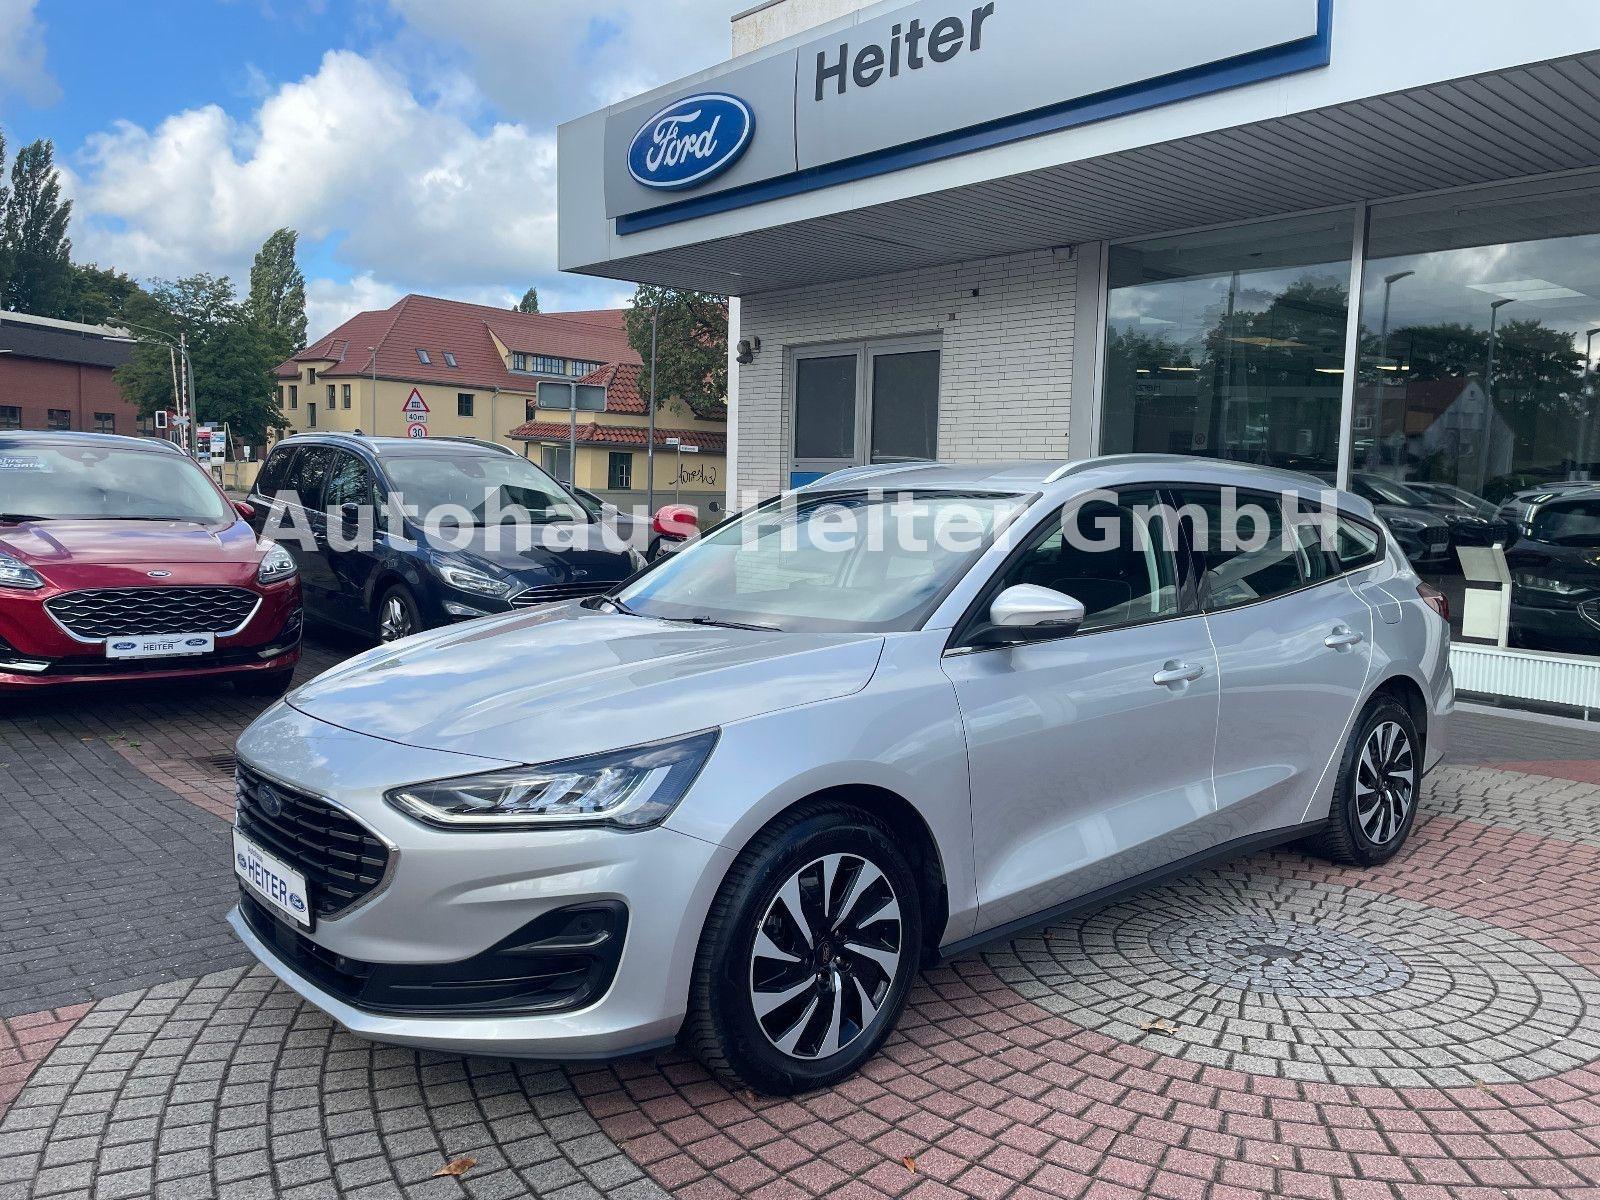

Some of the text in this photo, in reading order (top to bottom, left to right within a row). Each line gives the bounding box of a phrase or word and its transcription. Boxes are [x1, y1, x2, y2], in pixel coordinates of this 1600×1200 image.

[814, 2, 995, 102] Heiter
[645, 109, 721, 173] Ford
[412, 428, 423, 438] 30
[143, 643, 174, 652] HEITER
[247, 856, 288, 906] HEITER
